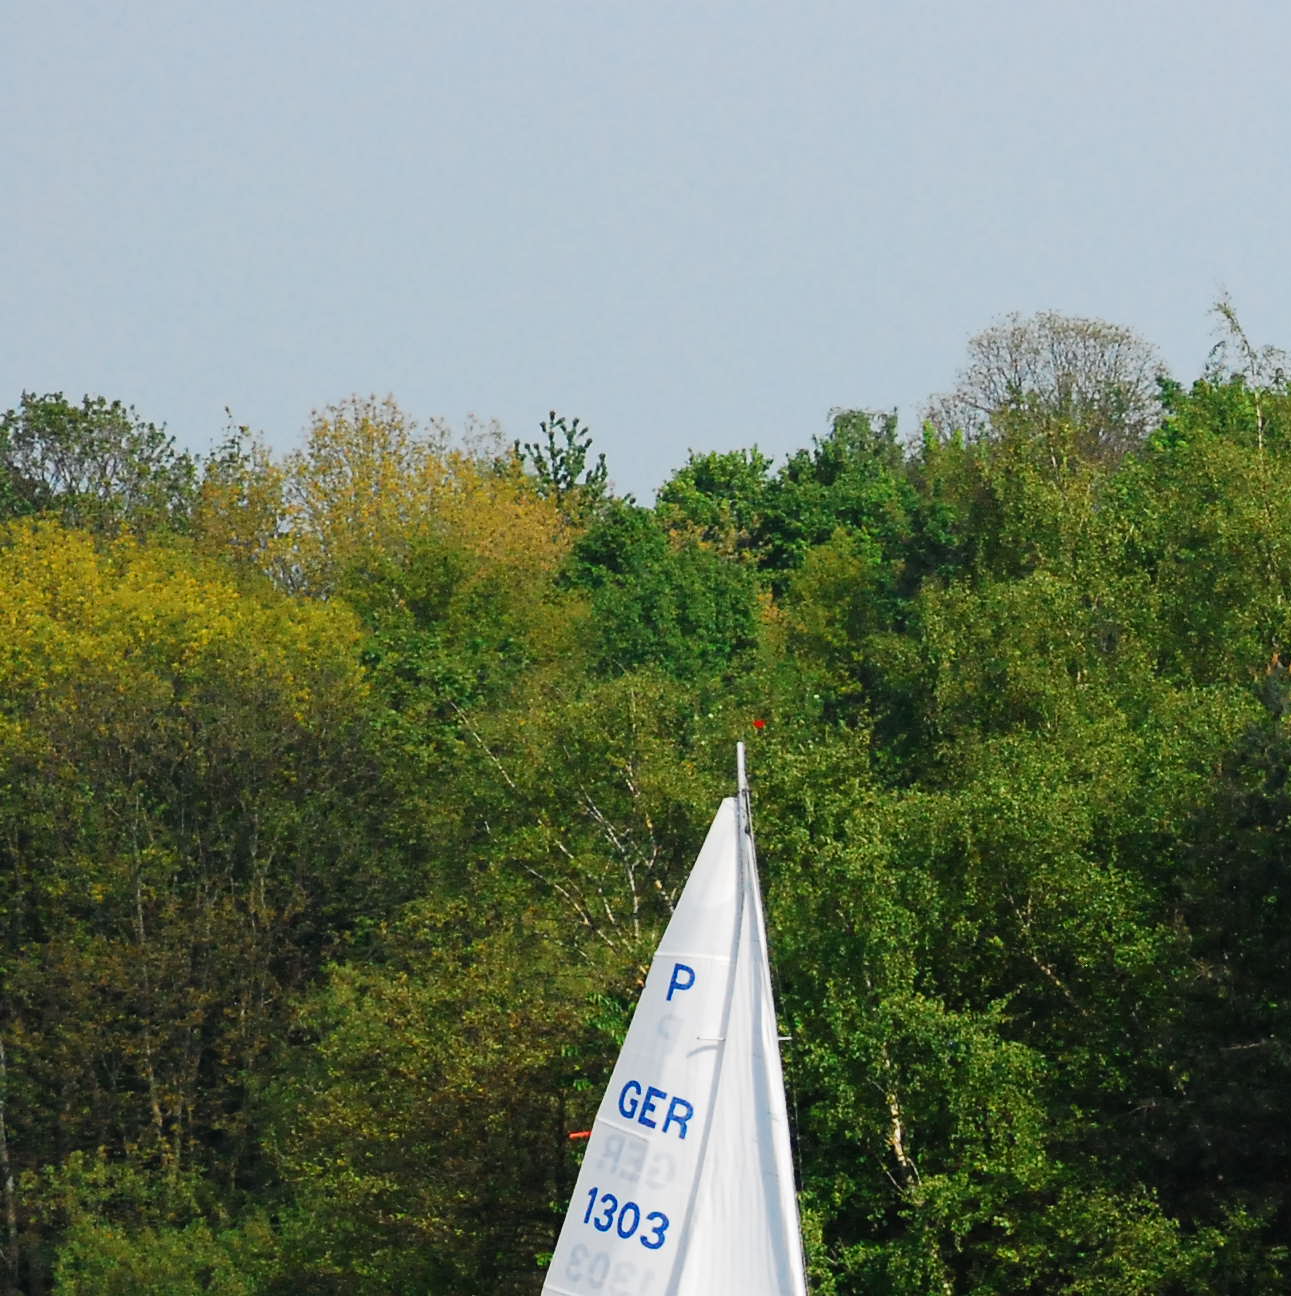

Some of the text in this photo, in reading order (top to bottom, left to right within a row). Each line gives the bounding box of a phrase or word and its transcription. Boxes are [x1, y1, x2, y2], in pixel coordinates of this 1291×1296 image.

[665, 962, 696, 1002] P
[617, 1079, 694, 1140] GER
[583, 1186, 670, 1250] 1303
